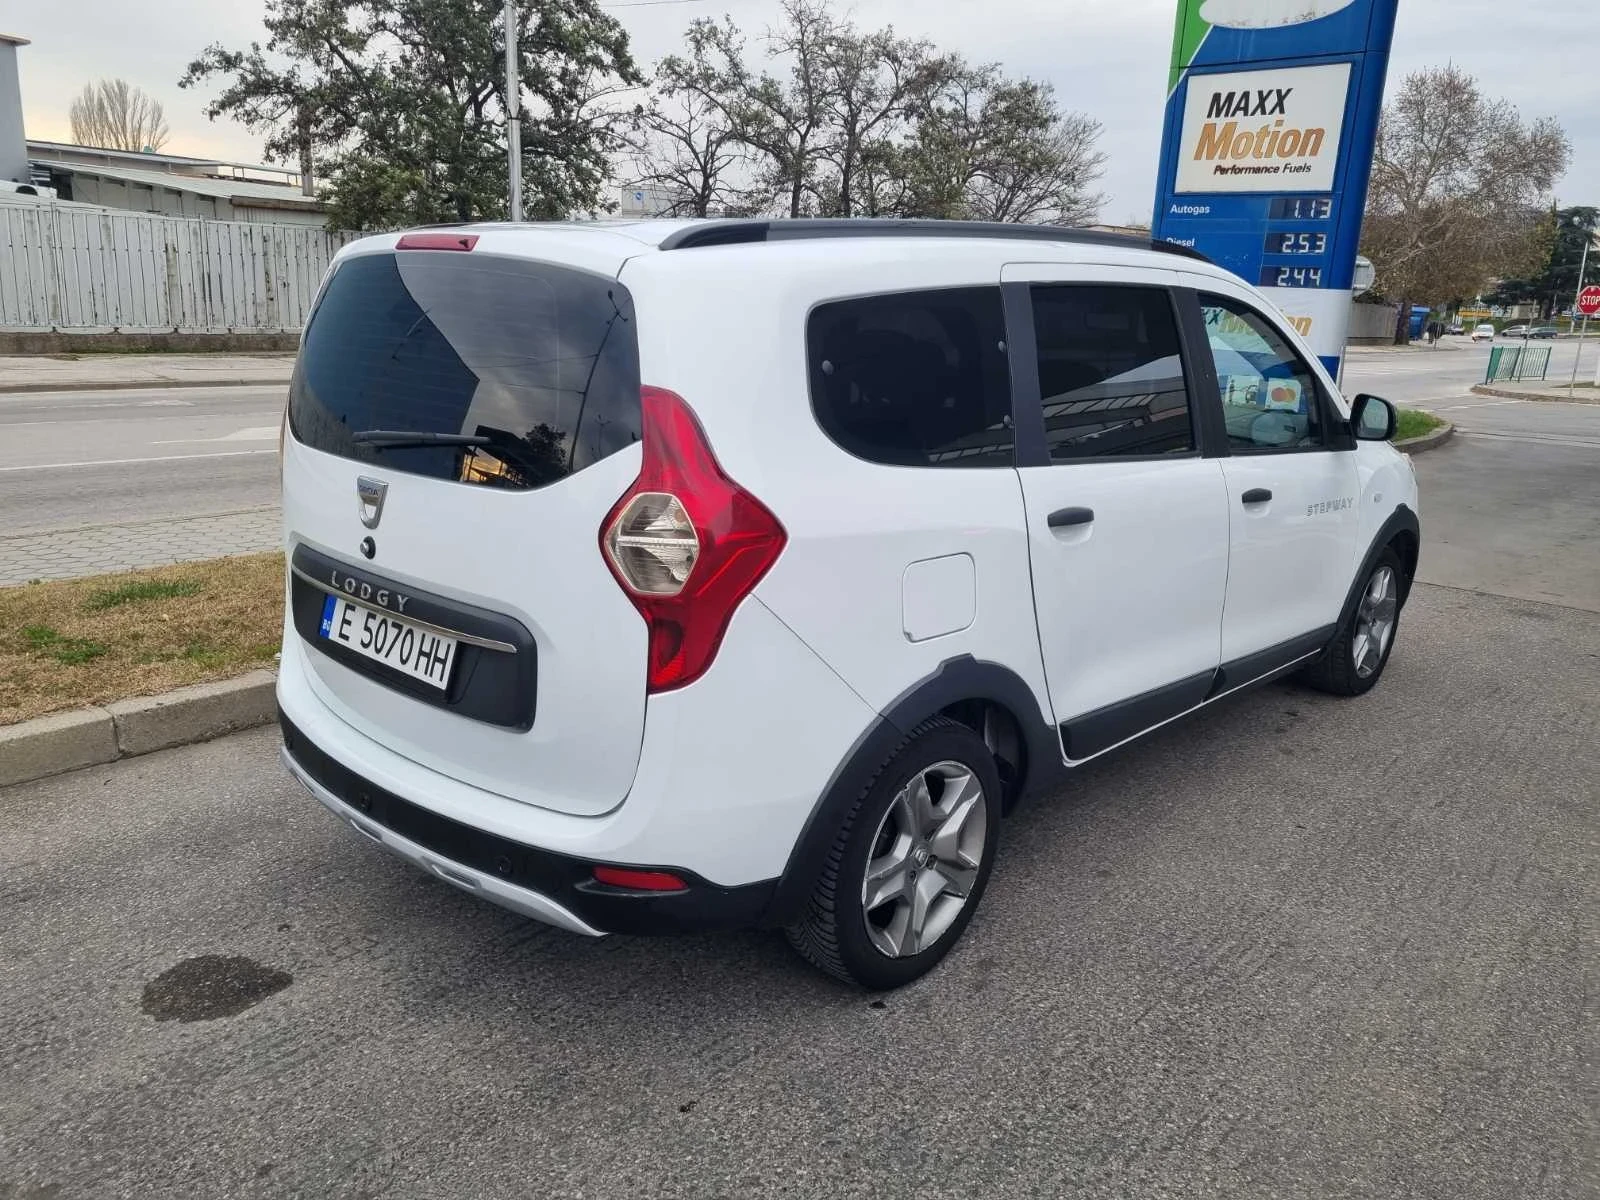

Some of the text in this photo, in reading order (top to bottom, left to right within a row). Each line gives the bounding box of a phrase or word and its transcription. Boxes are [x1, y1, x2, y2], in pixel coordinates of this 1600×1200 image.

[1206, 88, 1293, 119] MAXX
[1193, 119, 1326, 161] Motion
[1213, 162, 1312, 176] Performance Fuels
[1170, 199, 1332, 219] Autogas 1.13
[1282, 234, 1326, 253] 2.53
[1277, 267, 1321, 287] 2.44
[1581, 295, 1600, 306] STOP
[1306, 496, 1354, 517] STEPWAY
[331, 570, 409, 613] LODGY
[338, 603, 452, 682] E 5070 HH
